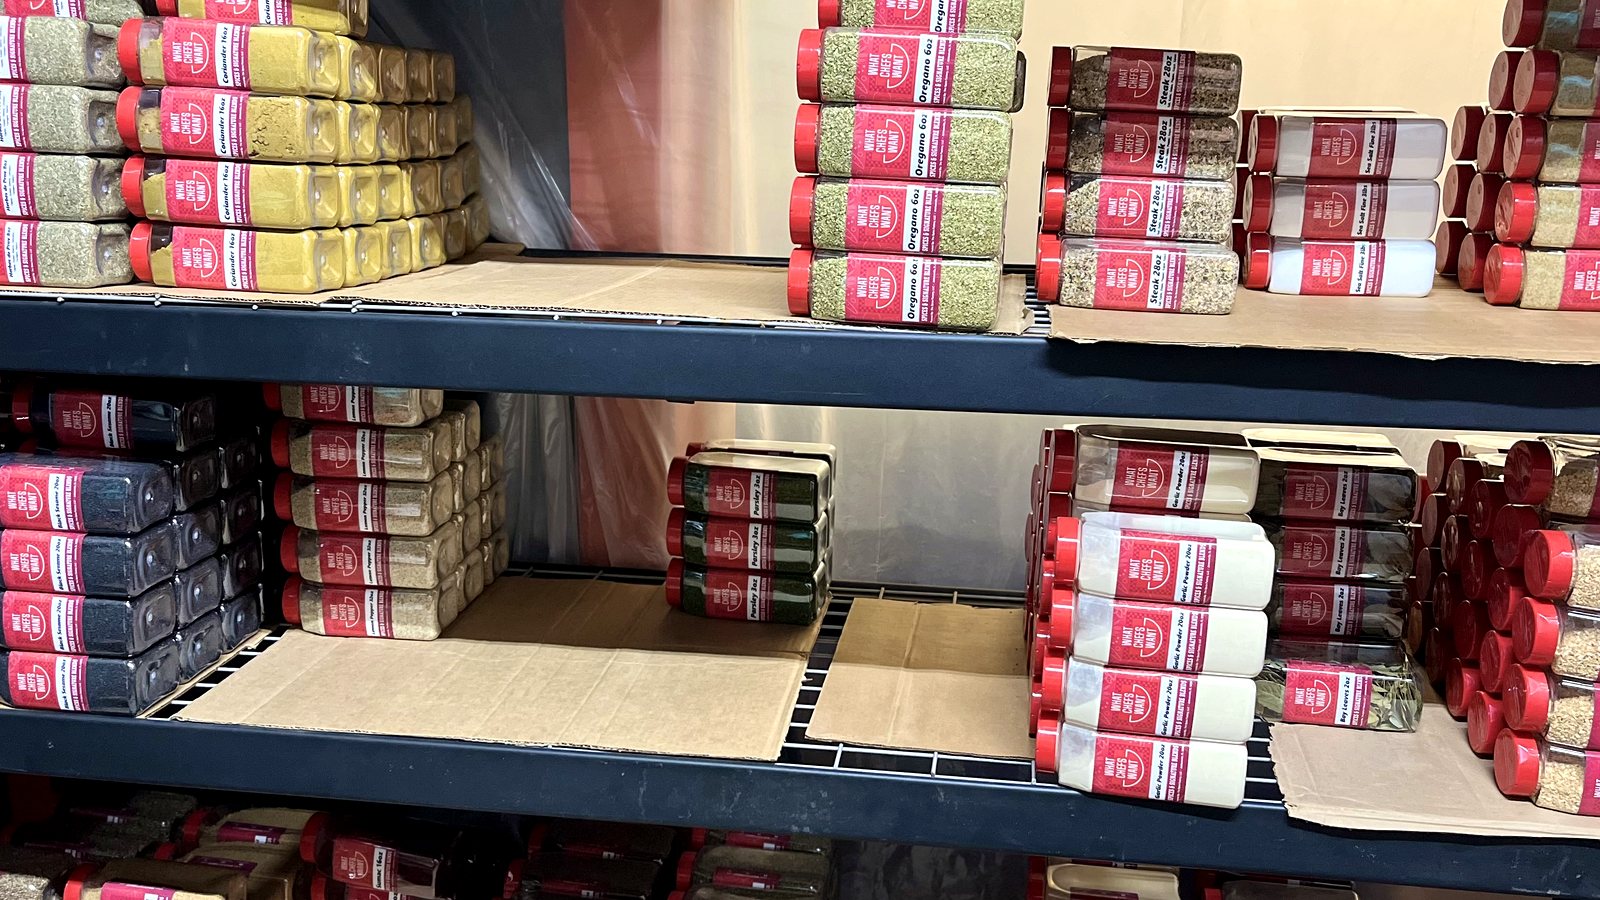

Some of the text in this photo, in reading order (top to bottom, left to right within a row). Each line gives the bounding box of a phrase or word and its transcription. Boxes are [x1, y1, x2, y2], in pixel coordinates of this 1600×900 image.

[172, 42, 183, 62] WHAT
[183, 42, 193, 64] CHEFS
[194, 43, 204, 64] WANT
[220, 46, 228, 84] Coriander
[868, 53, 879, 76] WHAT
[880, 53, 892, 78] CHEFS
[892, 55, 904, 79] WANT
[919, 38, 933, 103] Oregano 6oz
[1163, 55, 1173, 76] 28oz
[1159, 77, 1170, 105] Steak
[219, 117, 227, 154] Coriander
[864, 129, 875, 151] WHAT
[1159, 120, 1168, 140] 28oz
[876, 129, 888, 154] CHEFS
[887, 130, 900, 154] WANT
[915, 114, 928, 177] Oregano 6oz
[1155, 142, 1166, 170] Steak
[175, 180, 186, 200] WHAT
[186, 180, 196, 202] CHEFS
[196, 181, 207, 202] WANT
[223, 183, 231, 220] Coriander
[1107, 197, 1118, 216] WHAT
[1117, 197, 1128, 217] CHEFS
[1127, 198, 1139, 218] WANT
[1149, 185, 1161, 233] Steak 28oz
[856, 204, 868, 226] WHAT
[868, 204, 880, 229] CHEFS
[880, 206, 892, 229] WANT
[908, 189, 920, 250] Oregano 6oz
[229, 251, 237, 287] Coriander
[1106, 268, 1117, 287] WHAT
[1312, 259, 1321, 276] WHAT
[1321, 258, 1332, 277] CHEFS
[1331, 259, 1342, 277] WANT
[856, 277, 868, 298] WHAT
[868, 276, 880, 300] CHEFS
[879, 277, 891, 300] WANT
[1117, 268, 1128, 289] CHEFS
[1127, 269, 1139, 289] WANT
[1149, 255, 1162, 304] Steak 28oz
[907, 277, 918, 320] Oregano
[7, 491, 17, 510] WHAT
[17, 491, 27, 511] CHEFS
[27, 492, 38, 511] WANT
[754, 488, 762, 516] Parsley
[1172, 492, 1180, 507] Garlic
[1338, 505, 1346, 517] Bay
[752, 540, 760, 566] Parsley
[1337, 543, 1345, 563] Leaves
[1129, 558, 1140, 579] WHAT
[1140, 558, 1153, 581] CHEFS
[1152, 560, 1165, 582] WANT
[1180, 586, 1188, 602] Garlic
[750, 592, 758, 619] Parsley
[1336, 600, 1344, 620] Leaves
[1122, 626, 1133, 647] WHAT
[1335, 621, 1343, 632] Bay
[1133, 626, 1145, 649] CHEFS
[1145, 628, 1157, 649] WANT
[17, 673, 27, 691] WHAT
[27, 672, 36, 692] CHEFS
[36, 674, 46, 692] WANT
[1294, 687, 1306, 706] WHAT
[1305, 687, 1316, 707] CHEFS
[1315, 688, 1326, 708] WANT
[1339, 711, 1348, 722] Bay
[1104, 757, 1115, 777] WHAT
[1115, 757, 1127, 778] CHEFS
[1126, 758, 1138, 779] WANT
[1156, 760, 1164, 783] Powder
